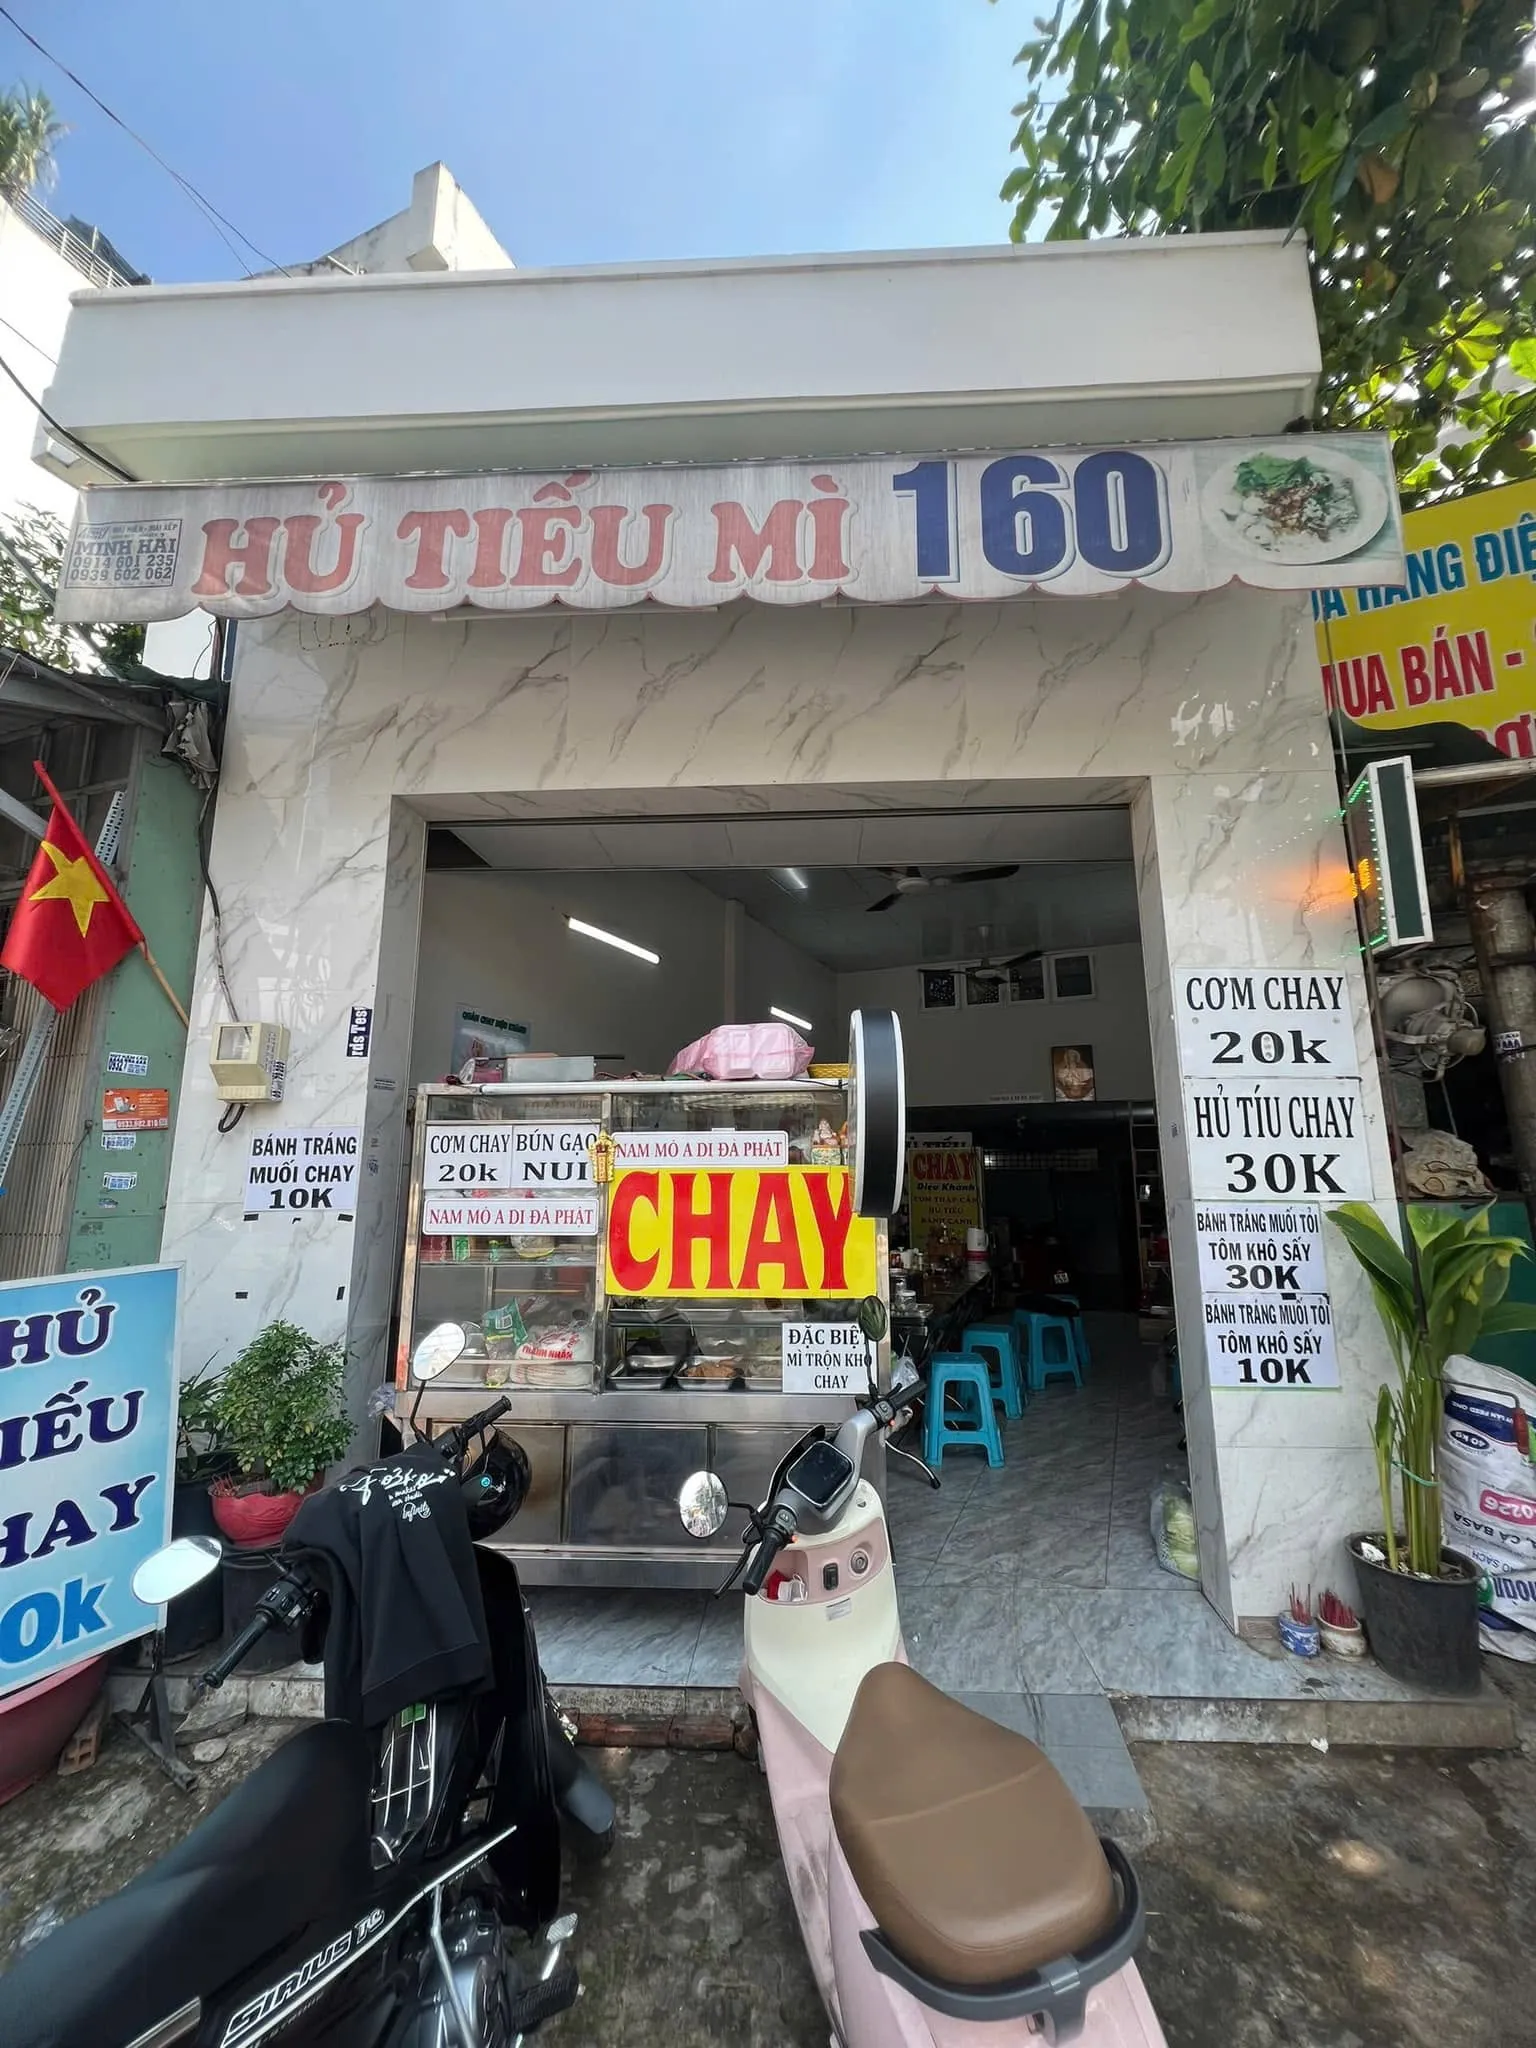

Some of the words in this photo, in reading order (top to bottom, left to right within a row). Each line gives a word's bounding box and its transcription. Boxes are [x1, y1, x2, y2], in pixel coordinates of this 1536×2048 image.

[190, 481, 368, 596] HỦ
[397, 471, 676, 590] TIẾU
[707, 474, 851, 583] MÌ
[893, 451, 1168, 580] 160
[75, 540, 132, 556] MINH
[70, 569, 109, 581] 0939
[114, 568, 140, 580] 602
[145, 567, 172, 580] 062
[73, 556, 111, 569] 0914
[115, 555, 140, 568] 601
[146, 554, 174, 567] 235
[1401, 625, 1495, 707] BÁN
[1186, 976, 1257, 1011] CƠM
[1263, 976, 1344, 1010] CHAY
[1210, 1030, 1332, 1064] 20k
[1193, 1083, 1231, 1138] HỦ
[1236, 1084, 1282, 1138] TÍU
[1288, 1096, 1355, 1138] CHAY
[252, 1133, 298, 1157] BÁNH
[303, 1132, 357, 1156] TRÁNG
[430, 1134, 466, 1154] CƠM
[469, 1133, 511, 1153] CHAY
[516, 1128, 554, 1152] BÚN
[615, 1143, 650, 1158] NAM
[682, 1142, 693, 1158] A
[696, 1142, 713, 1157] DI
[249, 1160, 298, 1185] MUỐI
[304, 1165, 355, 1183] CHAY
[438, 1163, 498, 1182] 20k
[522, 1162, 589, 1181] NUI
[913, 1152, 975, 1181] CHAY
[1225, 1153, 1347, 1194] 30K
[268, 1187, 334, 1210] 10K
[429, 1208, 463, 1225] NAM
[496, 1208, 505, 1225] A
[509, 1208, 525, 1225] DI
[1196, 1207, 1227, 1232] BÁNH
[1230, 1208, 1267, 1233] TRÁNG
[1269, 1206, 1298, 1233] MUỐI
[1300, 1206, 1320, 1233] TỎI
[609, 1171, 856, 1292] CHAY
[1208, 1237, 1242, 1261] TÔM
[1246, 1238, 1277, 1261] KHÔ
[1282, 1236, 1311, 1262] SẤY
[1225, 1264, 1301, 1290] 30K
[1205, 1298, 1237, 1324] BÁNH
[1240, 1299, 1277, 1325] TRÁNG
[1279, 1297, 1309, 1325] MUỐI
[0, 1288, 116, 1369] HỦ
[788, 1324, 825, 1349] ĐẶC
[1217, 1330, 1252, 1354] TÔM
[1256, 1330, 1289, 1354] KHÔ
[1293, 1328, 1322, 1355] SẤY
[787, 1349, 802, 1367] MÌ
[805, 1349, 841, 1371] TRỘN
[845, 1353, 869, 1367] KH
[1237, 1358, 1312, 1384] 10K
[814, 1374, 849, 1389] CHAY
[1453, 1510, 1496, 1537] BASA
[221, 1930, 353, 2047] SIRIUS
